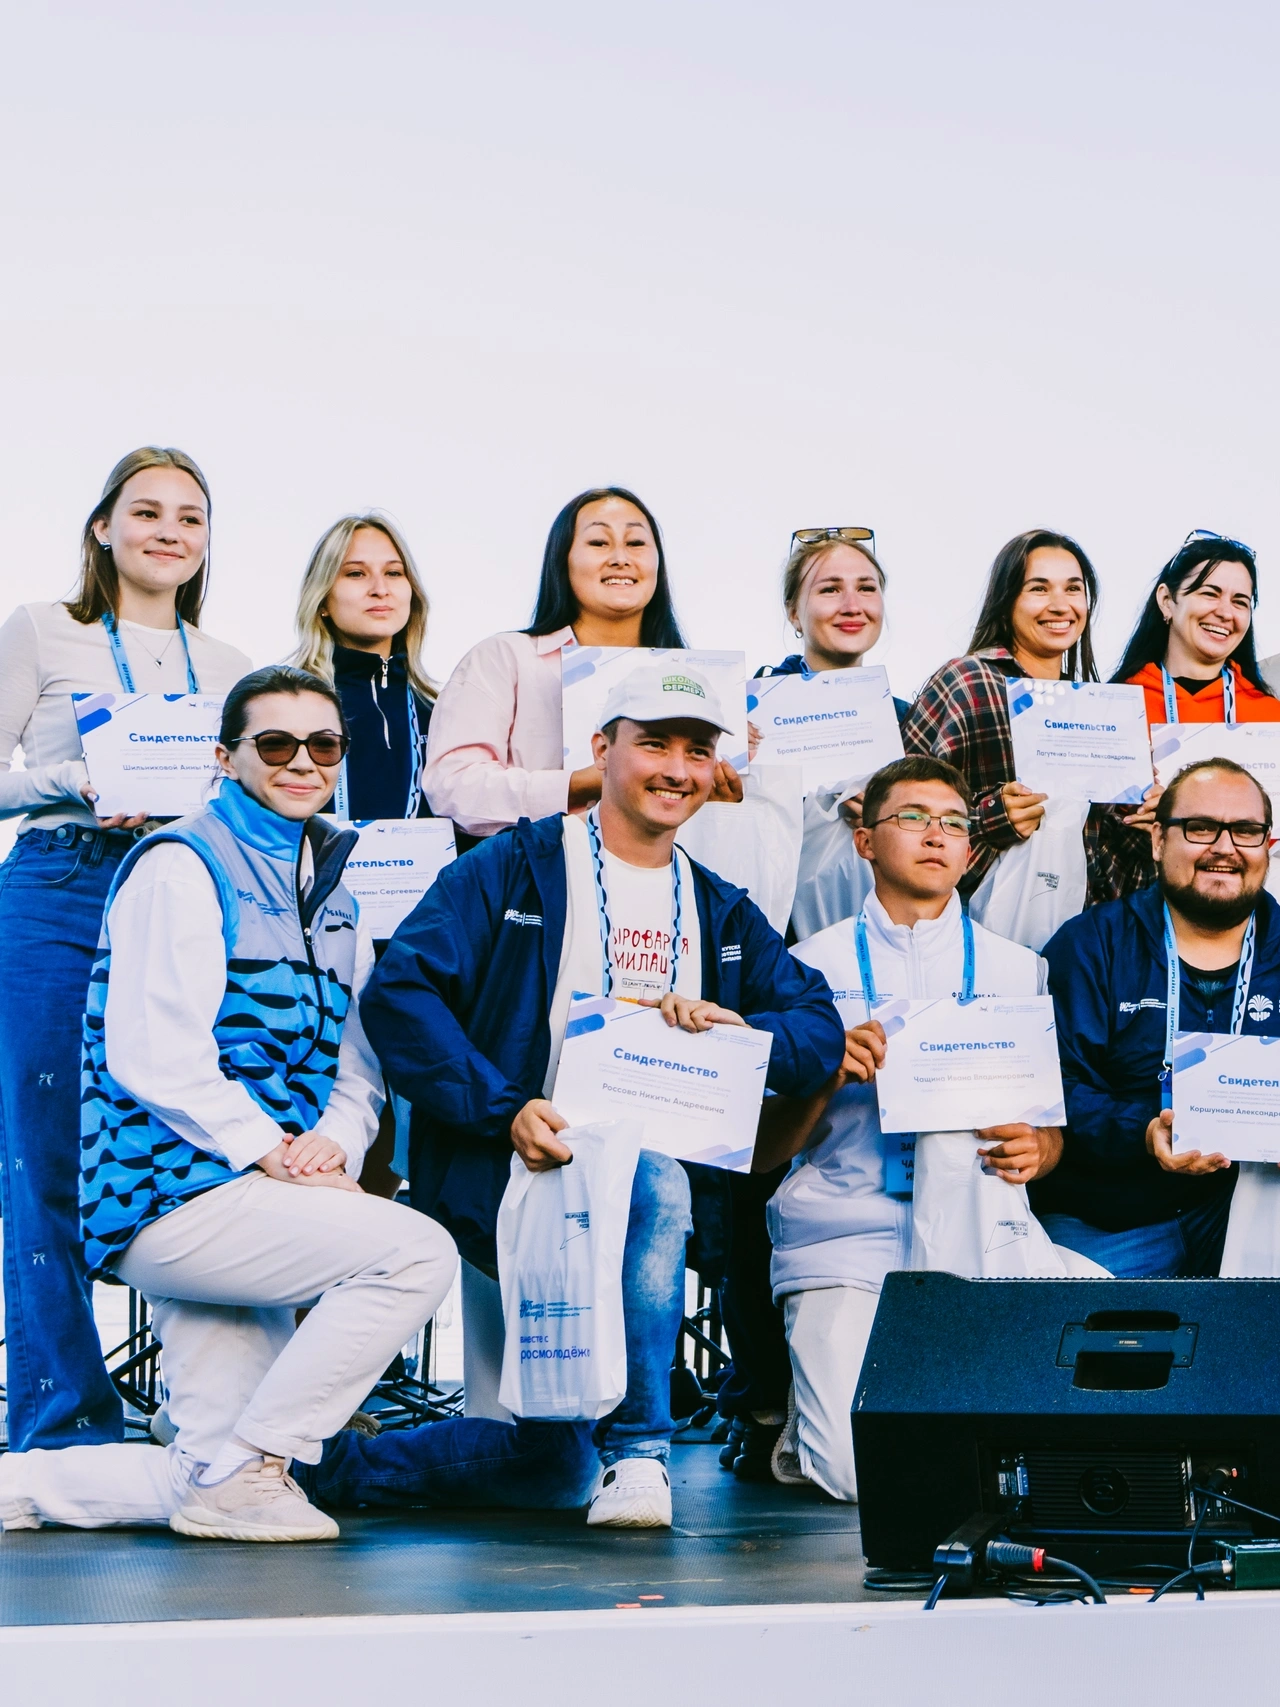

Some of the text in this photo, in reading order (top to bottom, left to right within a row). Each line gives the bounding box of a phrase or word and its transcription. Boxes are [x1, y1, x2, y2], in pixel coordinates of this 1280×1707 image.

[663, 684, 706, 698] ФЕРМЕРА
[773, 709, 858, 726] Свидетельство
[1044, 719, 1117, 732] Свидетельство
[129, 733, 220, 744] Свидетельств
[777, 747, 802, 755] Бровко
[841, 738, 874, 747] Игоревны
[122, 763, 178, 771] Шильниковой
[343, 859, 414, 870] детельство
[380, 888, 424, 897] Сергеевны
[612, 927, 689, 955] ЫРОВАРЯ
[919, 1041, 1016, 1052] Свидетельство
[613, 1047, 719, 1079] Свидетельство
[913, 1074, 946, 1084] Чащина
[973, 1072, 1035, 1082] Владимировича
[601, 1082, 637, 1098] Россова
[639, 1090, 671, 1104] Никиты
[673, 1097, 725, 1115] Андреевича
[1189, 1105, 1234, 1116] Коршунова
